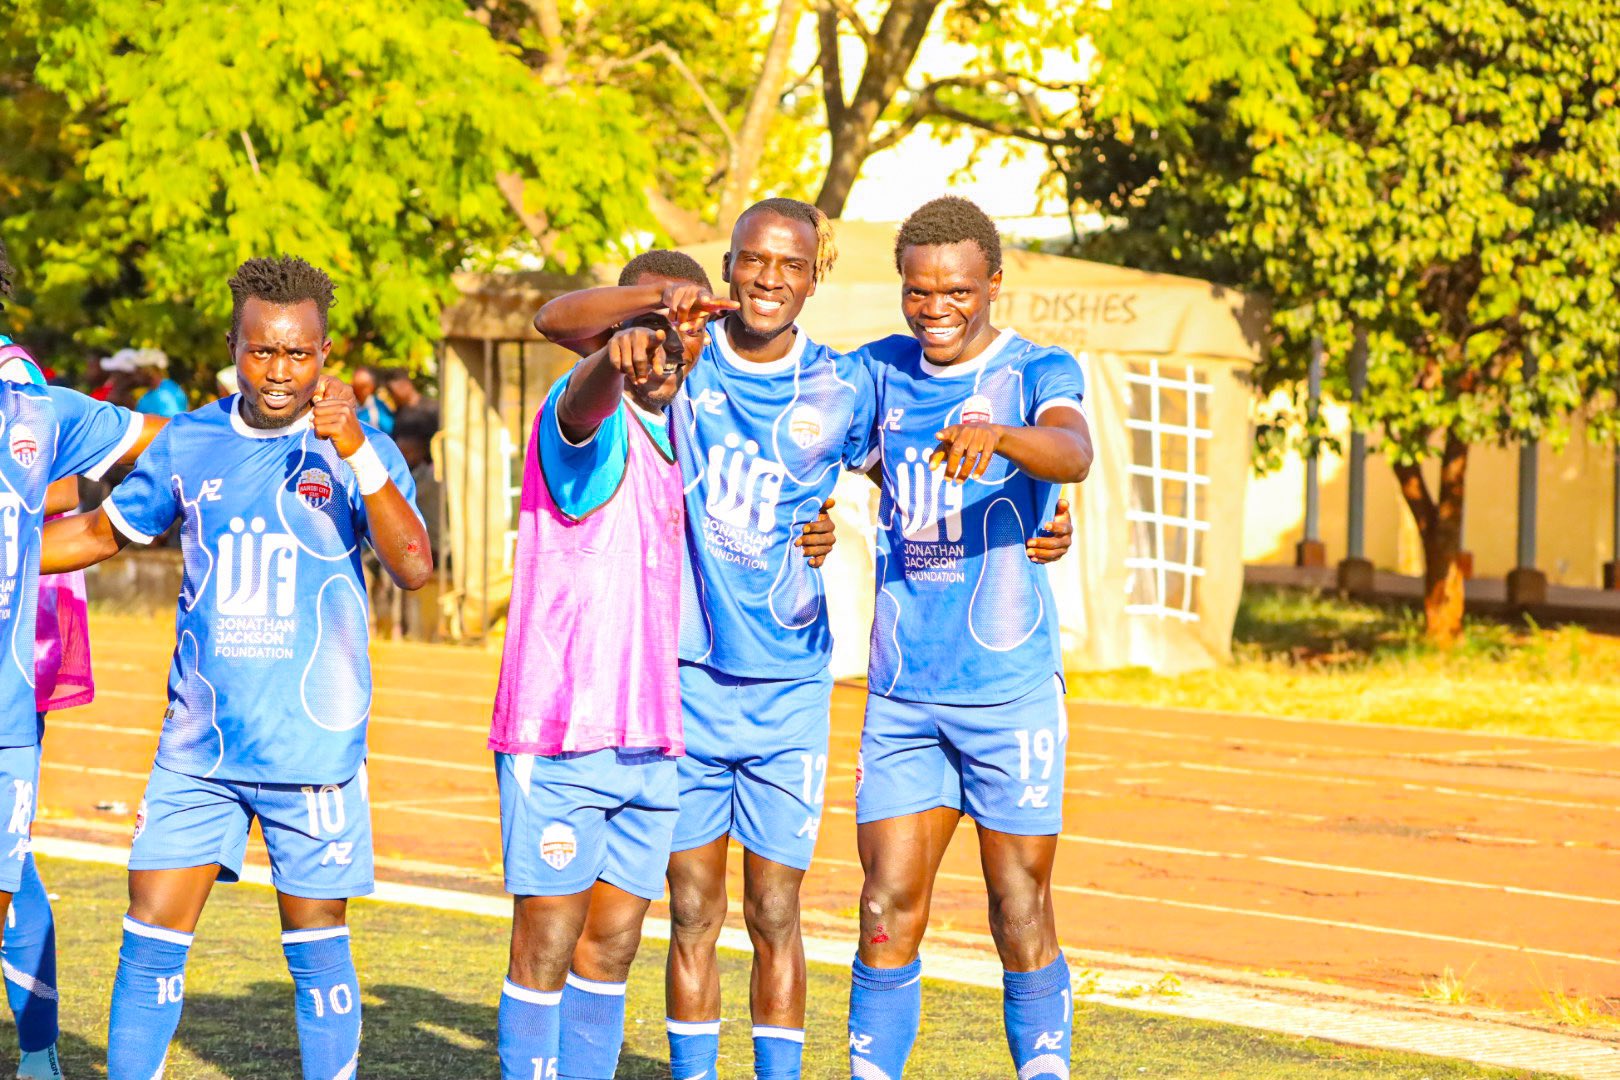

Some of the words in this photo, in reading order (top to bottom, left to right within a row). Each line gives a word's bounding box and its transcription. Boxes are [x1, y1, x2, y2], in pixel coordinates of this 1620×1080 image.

[1030, 291, 1138, 324] DISHES
[883, 408, 904, 430] AZ
[197, 478, 223, 502] AZ
[704, 516, 773, 547] JONATHAN
[905, 543, 964, 557] JONATHAN
[905, 557, 956, 569] JACKSON
[905, 570, 965, 583] FOUNDATION
[216, 618, 295, 632] JONATHAN
[215, 631, 284, 645] JACKSON
[215, 646, 294, 659] FOUNDATION
[1014, 728, 1055, 780] 19
[800, 753, 827, 805] 12
[1018, 785, 1049, 808] AZ
[301, 784, 345, 836] 10
[321, 841, 353, 865] AZ
[156, 974, 184, 1005] 10
[309, 983, 352, 1017] 10
[1034, 1030, 1064, 1050] AZ
